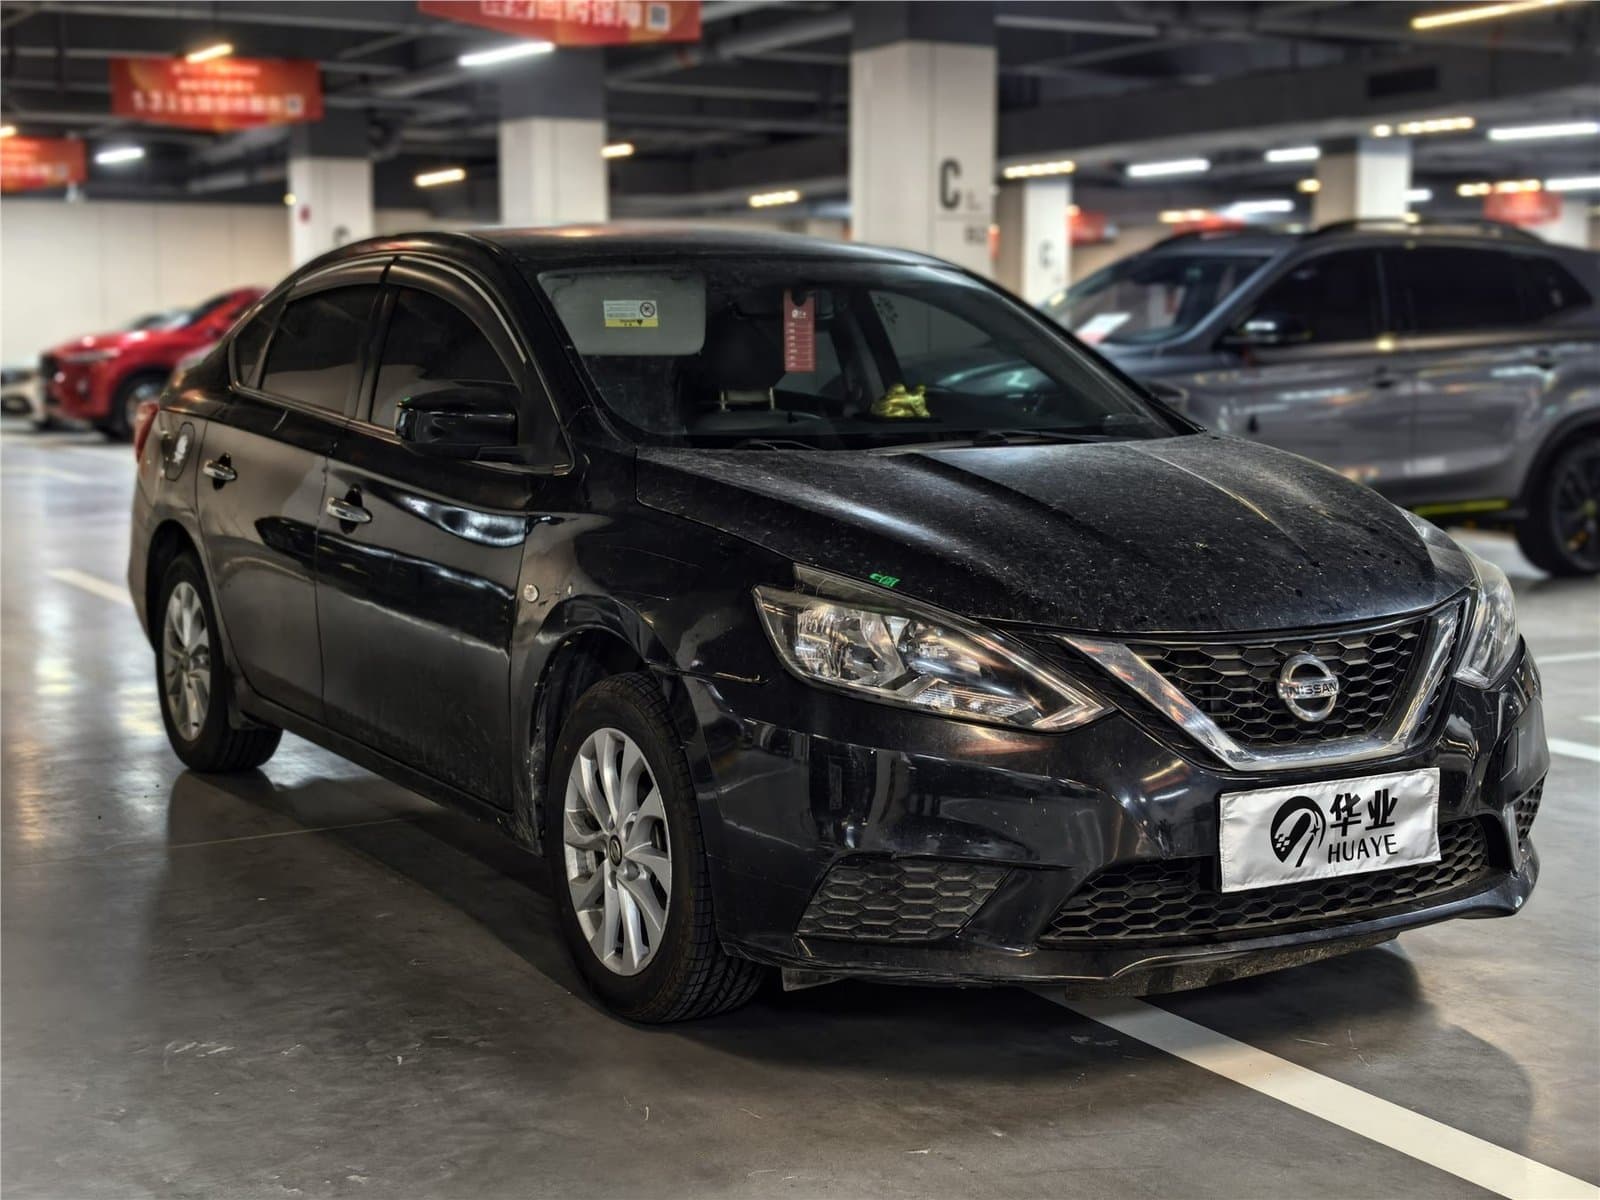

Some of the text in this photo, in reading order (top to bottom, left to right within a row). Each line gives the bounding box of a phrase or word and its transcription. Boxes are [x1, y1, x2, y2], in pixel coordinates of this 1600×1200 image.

[940, 158, 961, 210] C
[1289, 681, 1337, 697] NISSAN
[1330, 788, 1398, 837] 华业
[1328, 834, 1399, 864] HUAYE
